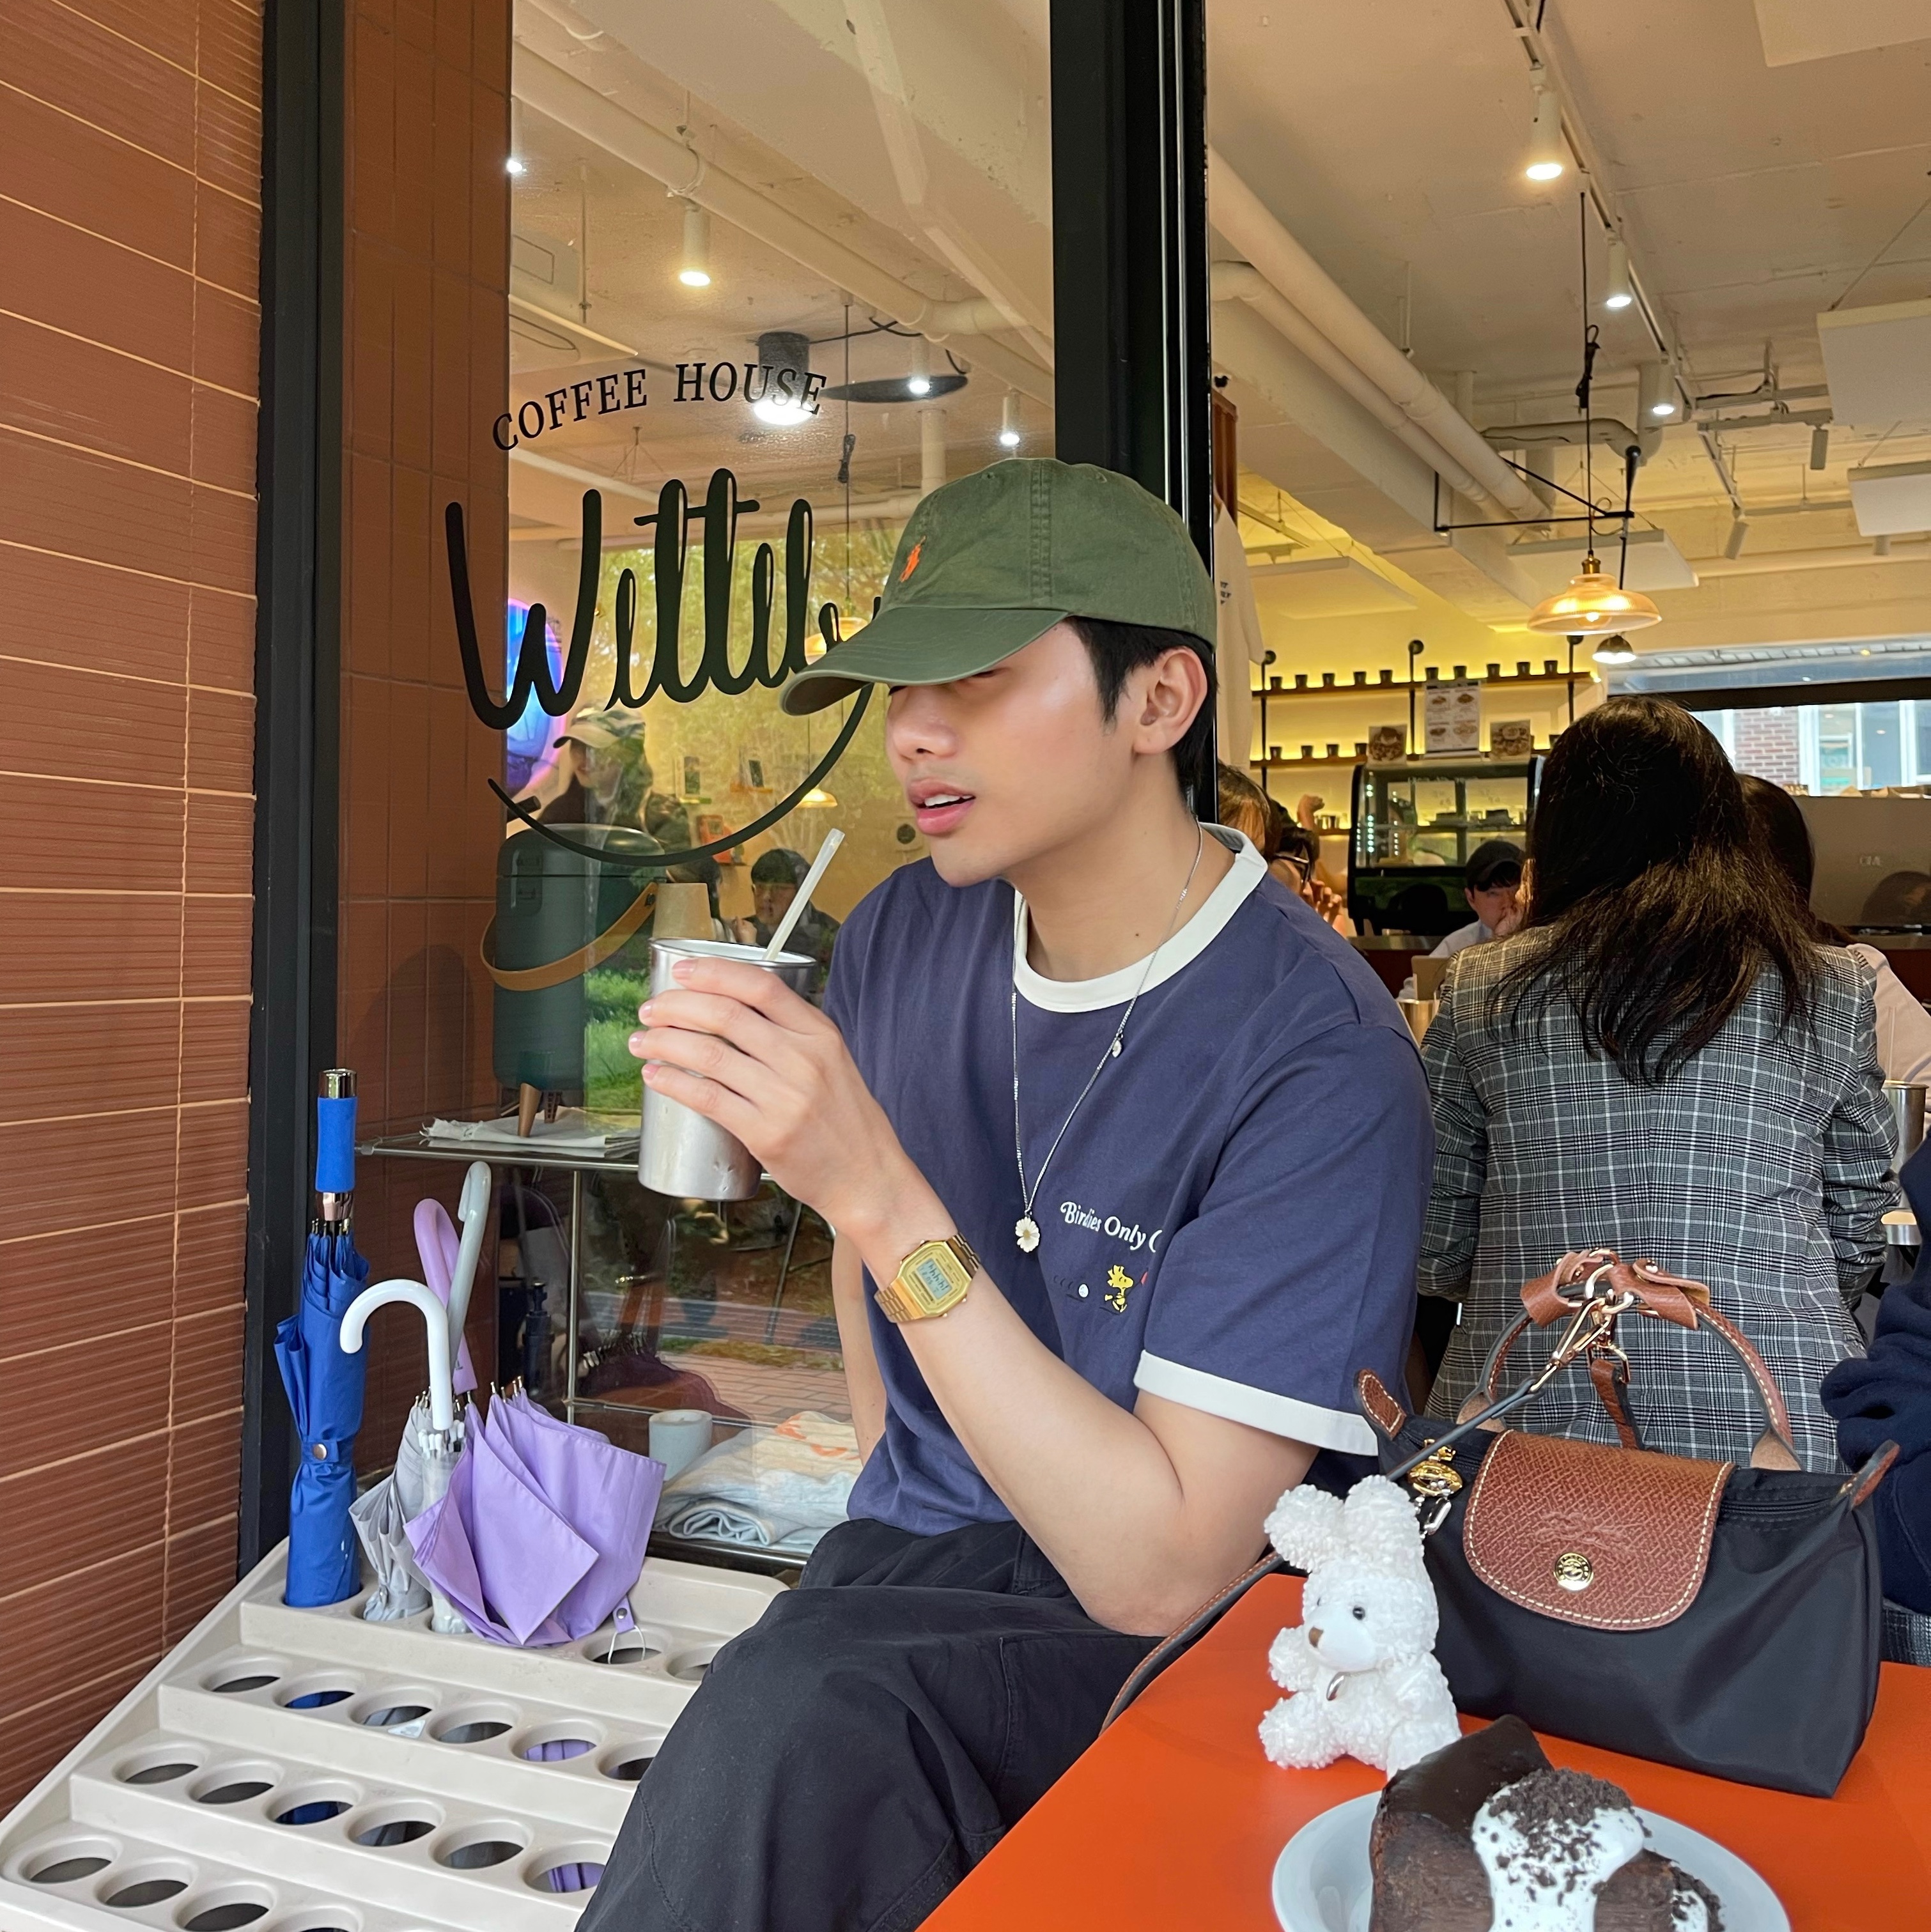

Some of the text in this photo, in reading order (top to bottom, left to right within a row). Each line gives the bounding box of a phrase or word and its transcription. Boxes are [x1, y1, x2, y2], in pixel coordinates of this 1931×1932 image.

[492, 362, 828, 451] COFFEE HOUSE
[1060, 1201, 1103, 1232] Birdies
[1104, 1216, 1146, 1251] Only
